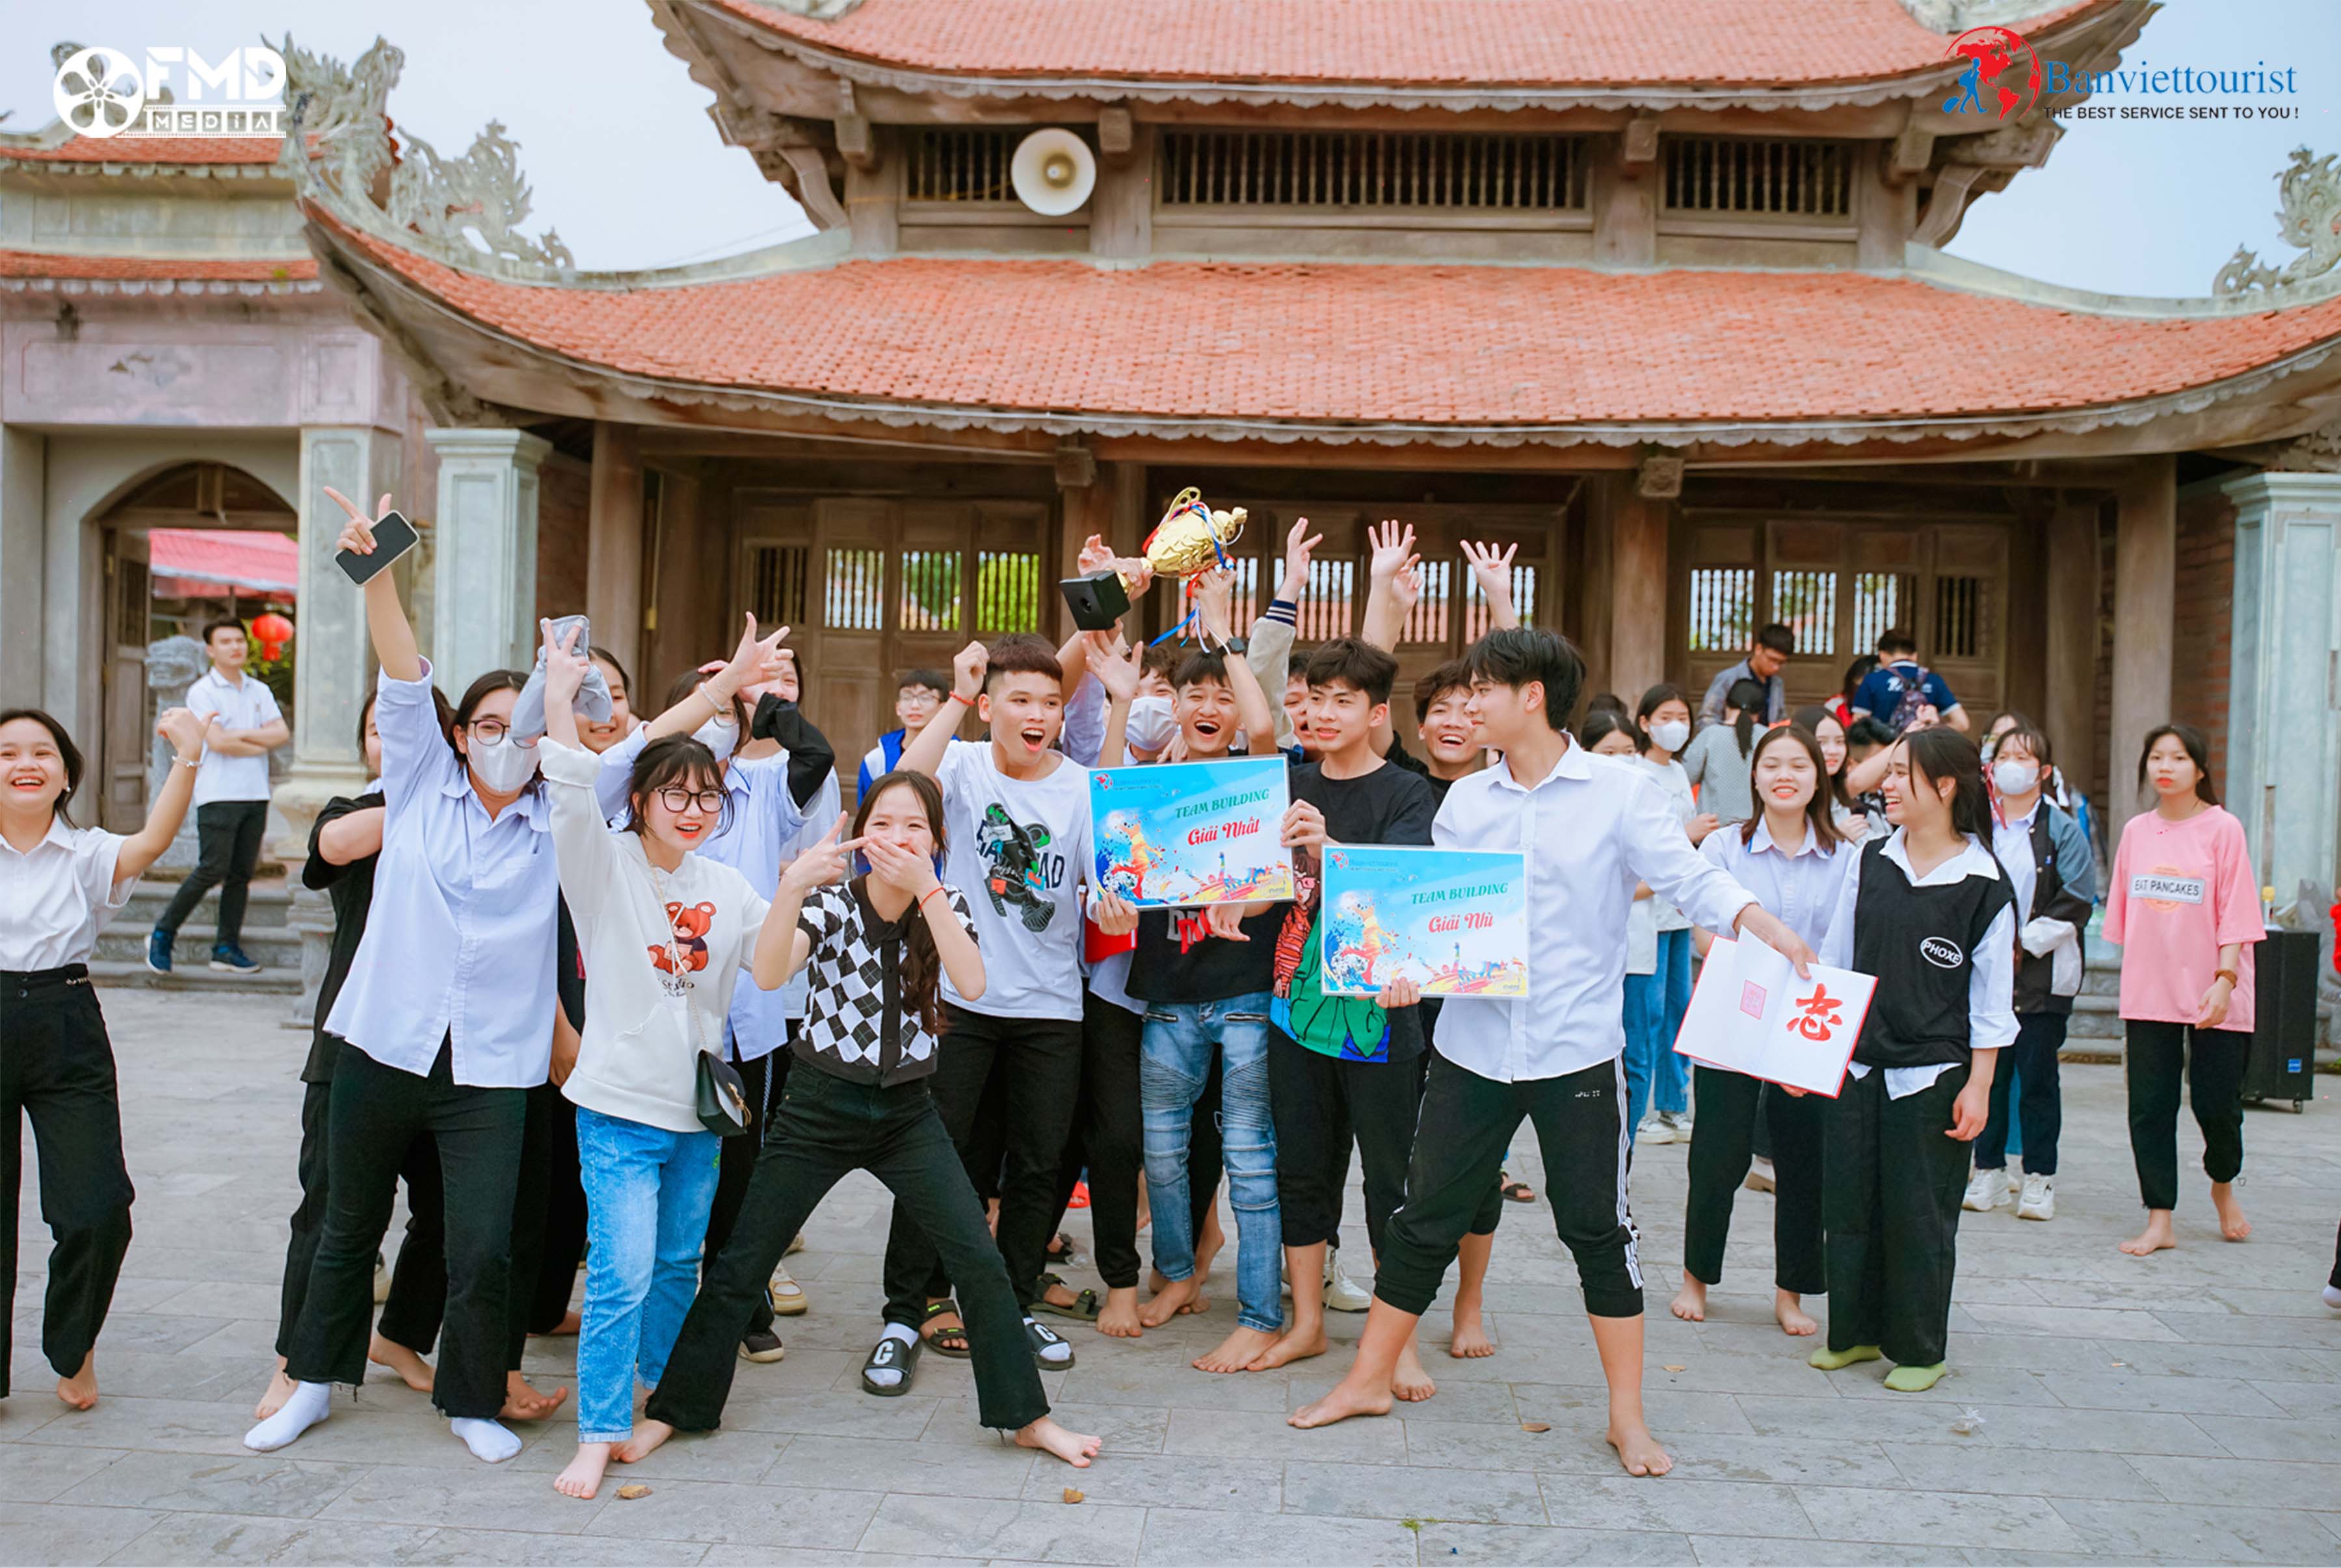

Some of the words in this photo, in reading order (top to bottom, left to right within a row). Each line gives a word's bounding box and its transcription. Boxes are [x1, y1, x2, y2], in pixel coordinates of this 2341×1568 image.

[1175, 802, 1209, 818] TEAM
[1211, 789, 1269, 811] BUILDING
[1187, 825, 1218, 846] Giải
[1222, 816, 1260, 839] Nhất
[1411, 889, 1446, 905] TEAM
[1449, 882, 1509, 900] BUILDING
[2150, 880, 2200, 896] PANCAKES
[1428, 913, 1461, 934] Giải
[1922, 941, 1960, 965] PHOXE
